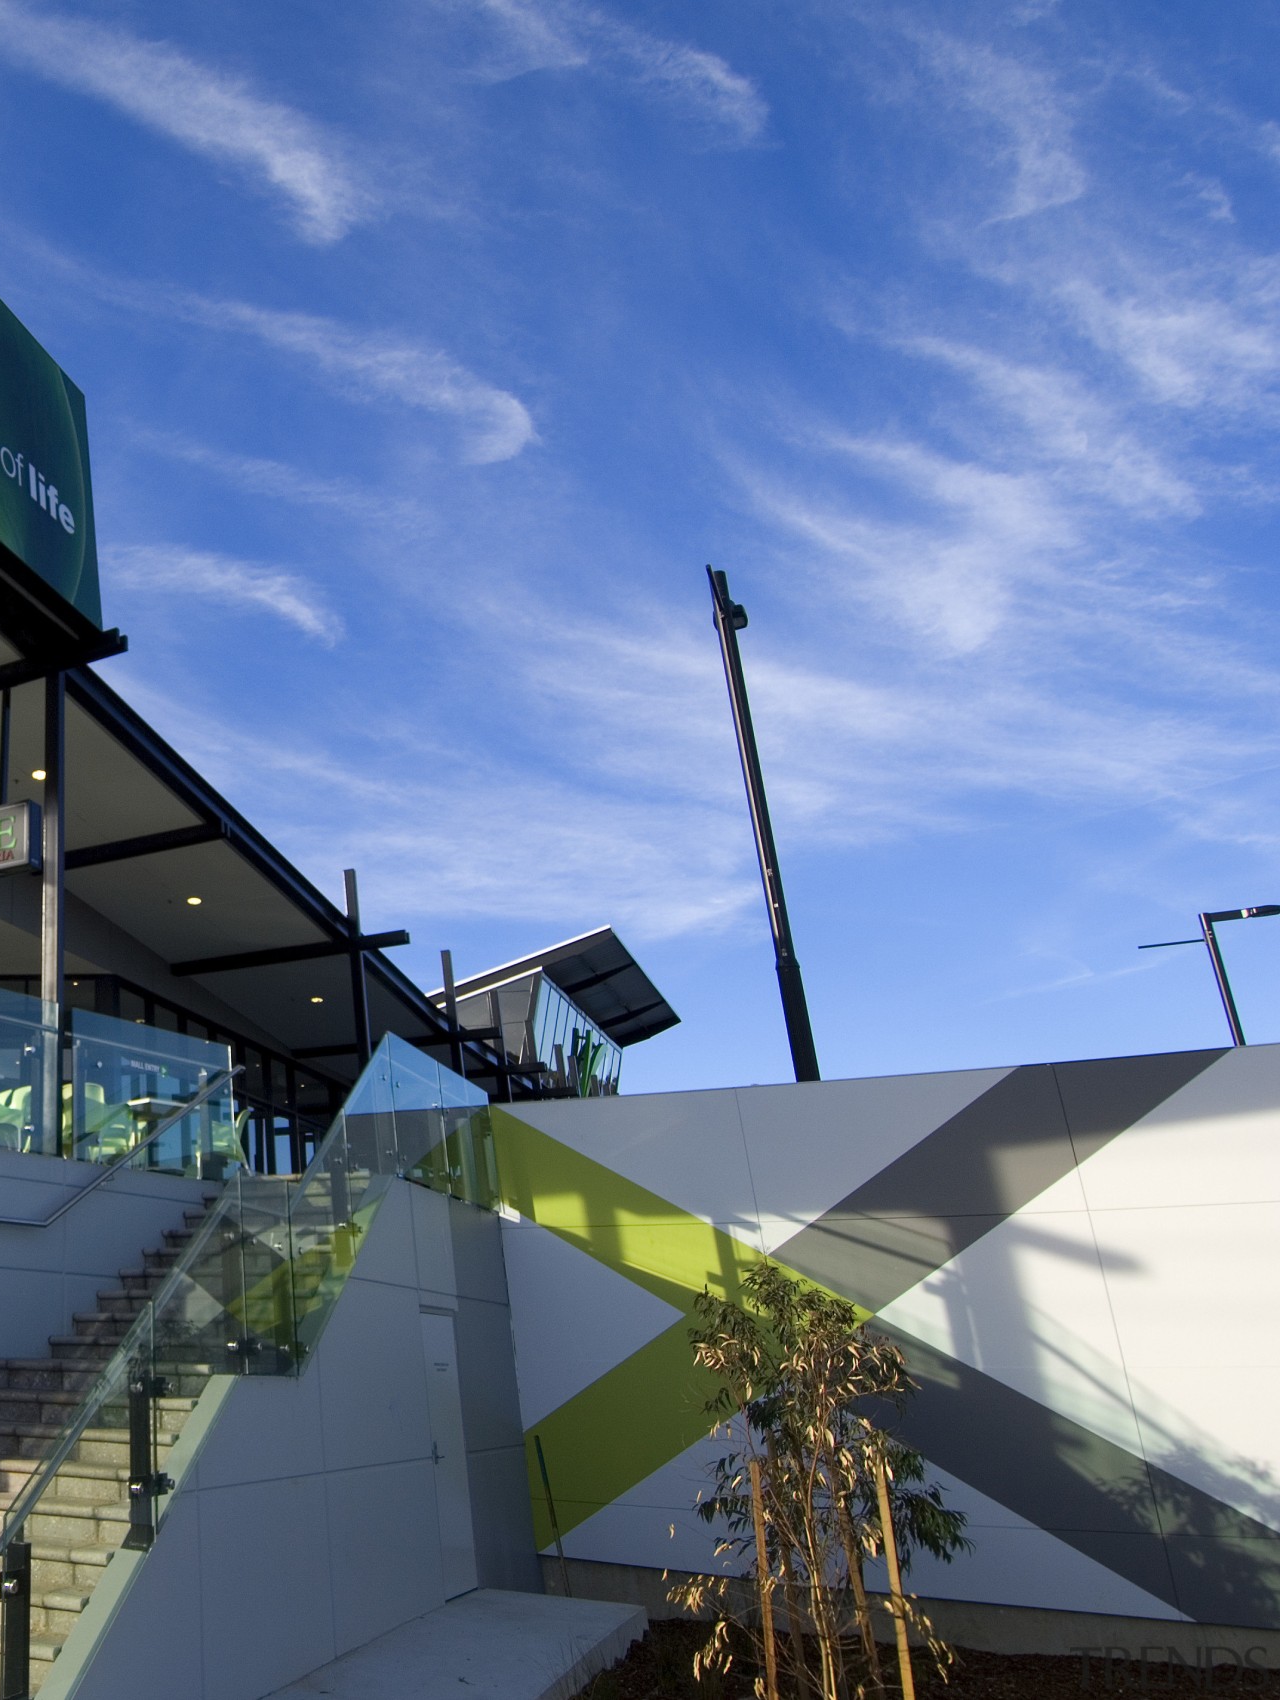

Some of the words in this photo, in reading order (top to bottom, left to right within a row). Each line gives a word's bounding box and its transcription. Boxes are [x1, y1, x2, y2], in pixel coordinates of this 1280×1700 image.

[0, 446, 25, 487] of
[28, 462, 76, 535] life
[130, 1059, 144, 1070] MALL
[144, 1062, 160, 1073] ENTRY
